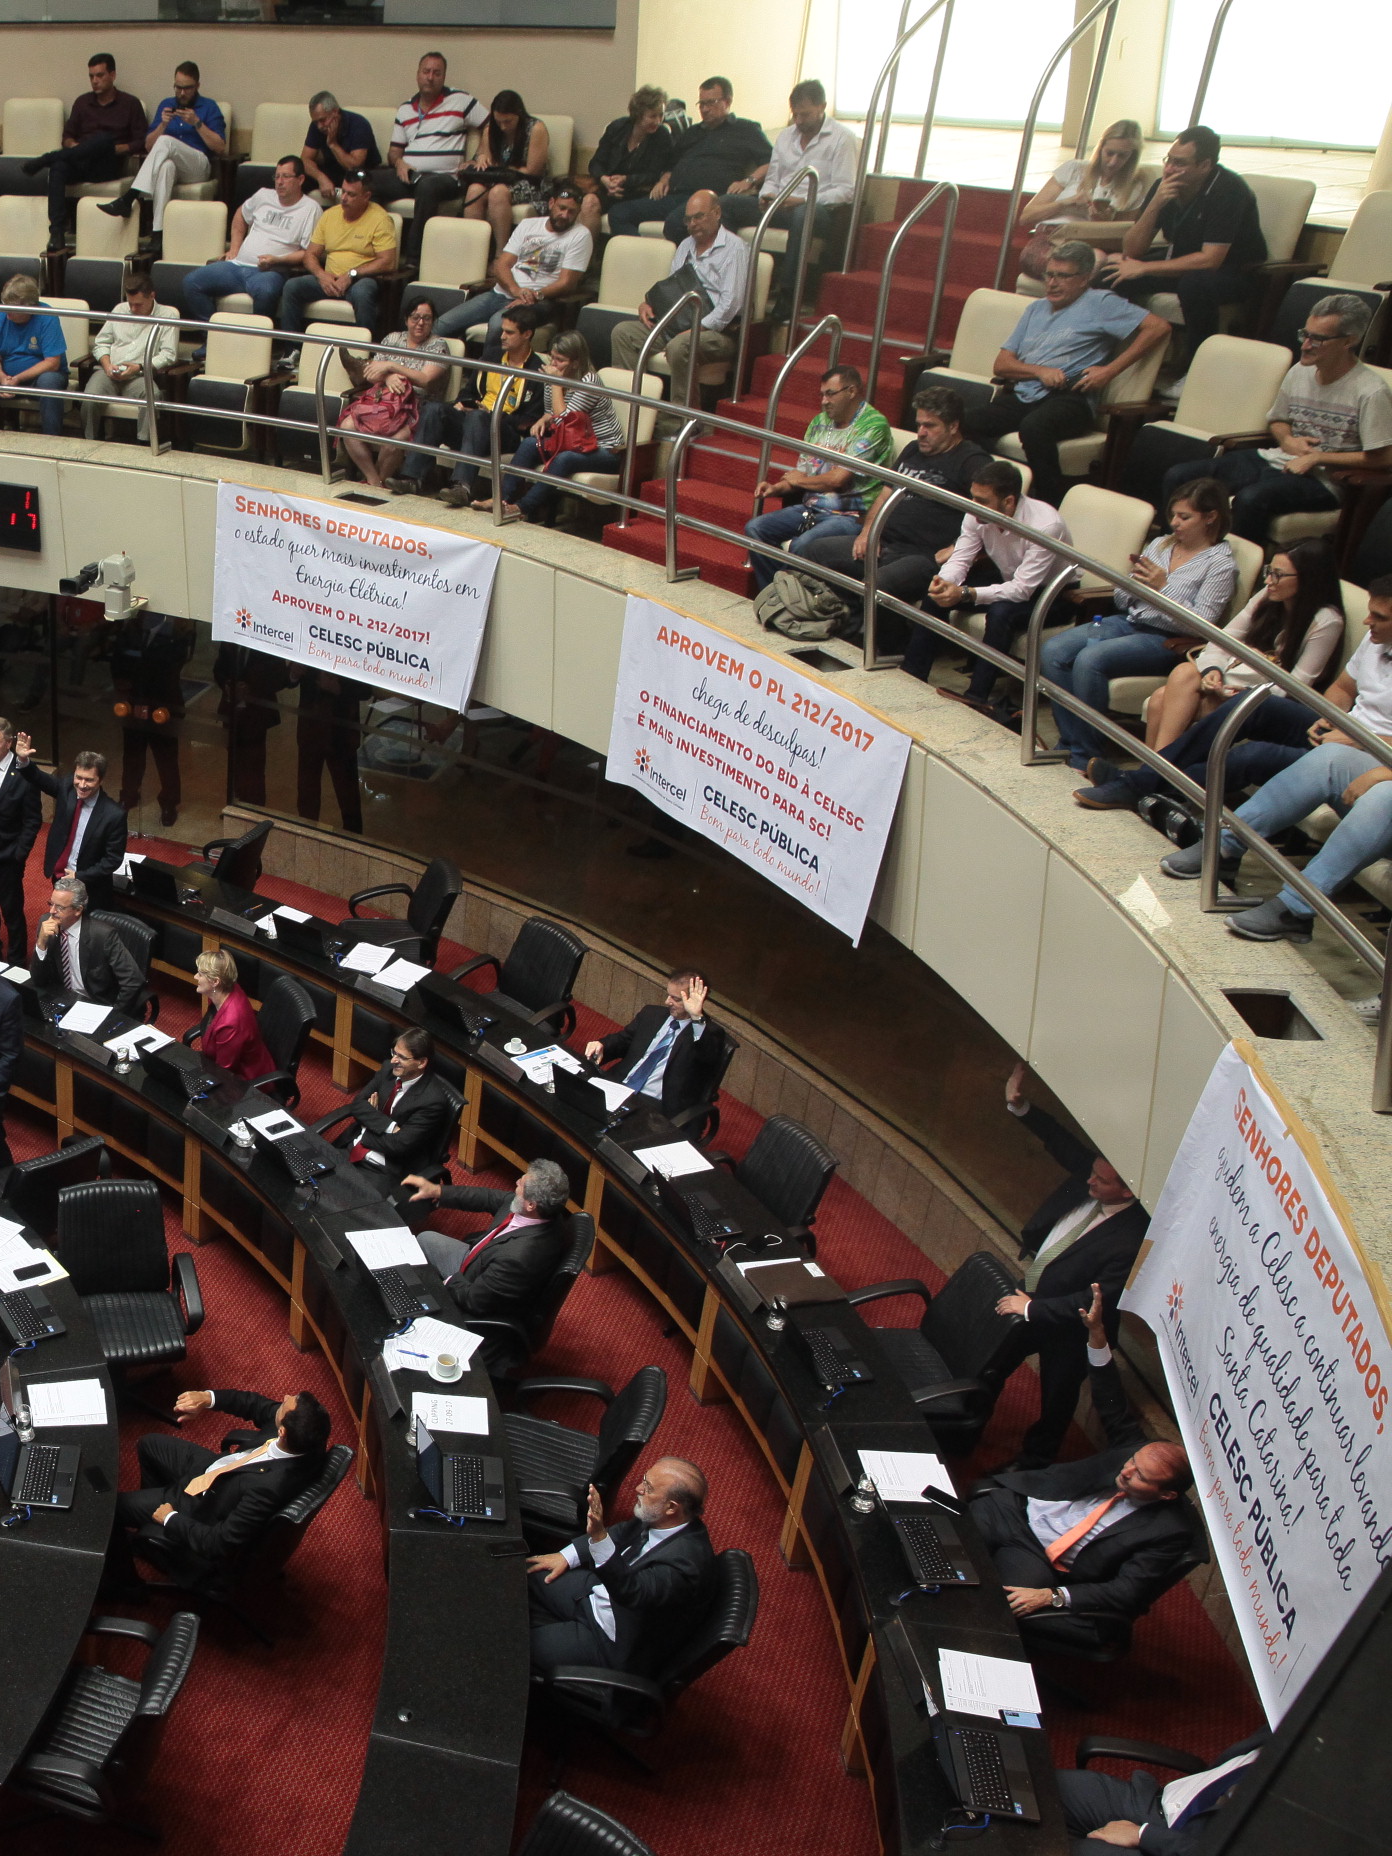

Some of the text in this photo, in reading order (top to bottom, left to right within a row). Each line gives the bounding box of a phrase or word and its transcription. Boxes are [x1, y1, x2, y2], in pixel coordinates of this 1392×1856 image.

[234, 525, 480, 599] o estado quer mais investimentos em
[235, 495, 432, 560] SENHORES DEPUTADOS,
[253, 621, 294, 643] Intercel
[272, 589, 431, 645] APROVEM O PL 212/2017!
[296, 565, 408, 610] Energia Elétrica!
[308, 641, 434, 690] Bom para todo mundo!
[309, 624, 363, 652] CELESC
[367, 642, 430, 672] PÚBLICA
[656, 625, 875, 752] APROVEM O PL 212/2017
[640, 690, 865, 831] O FINANCIAMENTO DO BID À CELESC
[692, 677, 826, 769] chega de desculpas!
[637, 710, 645, 727] É
[649, 719, 673, 745] MAIS
[676, 737, 770, 800] INVESTIMENTO
[772, 793, 805, 825] PARA
[808, 816, 832, 841] SC!
[649, 767, 687, 802] Intercel
[700, 803, 821, 897] Bom para todo mundo!
[703, 785, 757, 830] CELESC
[760, 819, 819, 873] PÚBLICA
[1215, 1146, 1249, 1226] ajudem
[1249, 1223, 1259, 1244] a
[1261, 1231, 1298, 1317] Celesc
[1294, 1315, 1306, 1338] a
[1304, 1334, 1356, 1463] continuar
[1234, 1087, 1389, 1435] SENHORES DEPUTADOS,
[1174, 1319, 1200, 1399] Intercel
[1209, 1216, 1356, 1592] energia de qualidade para toda
[1216, 1326, 1305, 1535] Santa Catarina!
[1199, 1418, 1288, 1674] Bom para todo mundo!
[1209, 1392, 1296, 1641] CELESC PÚBLICA
